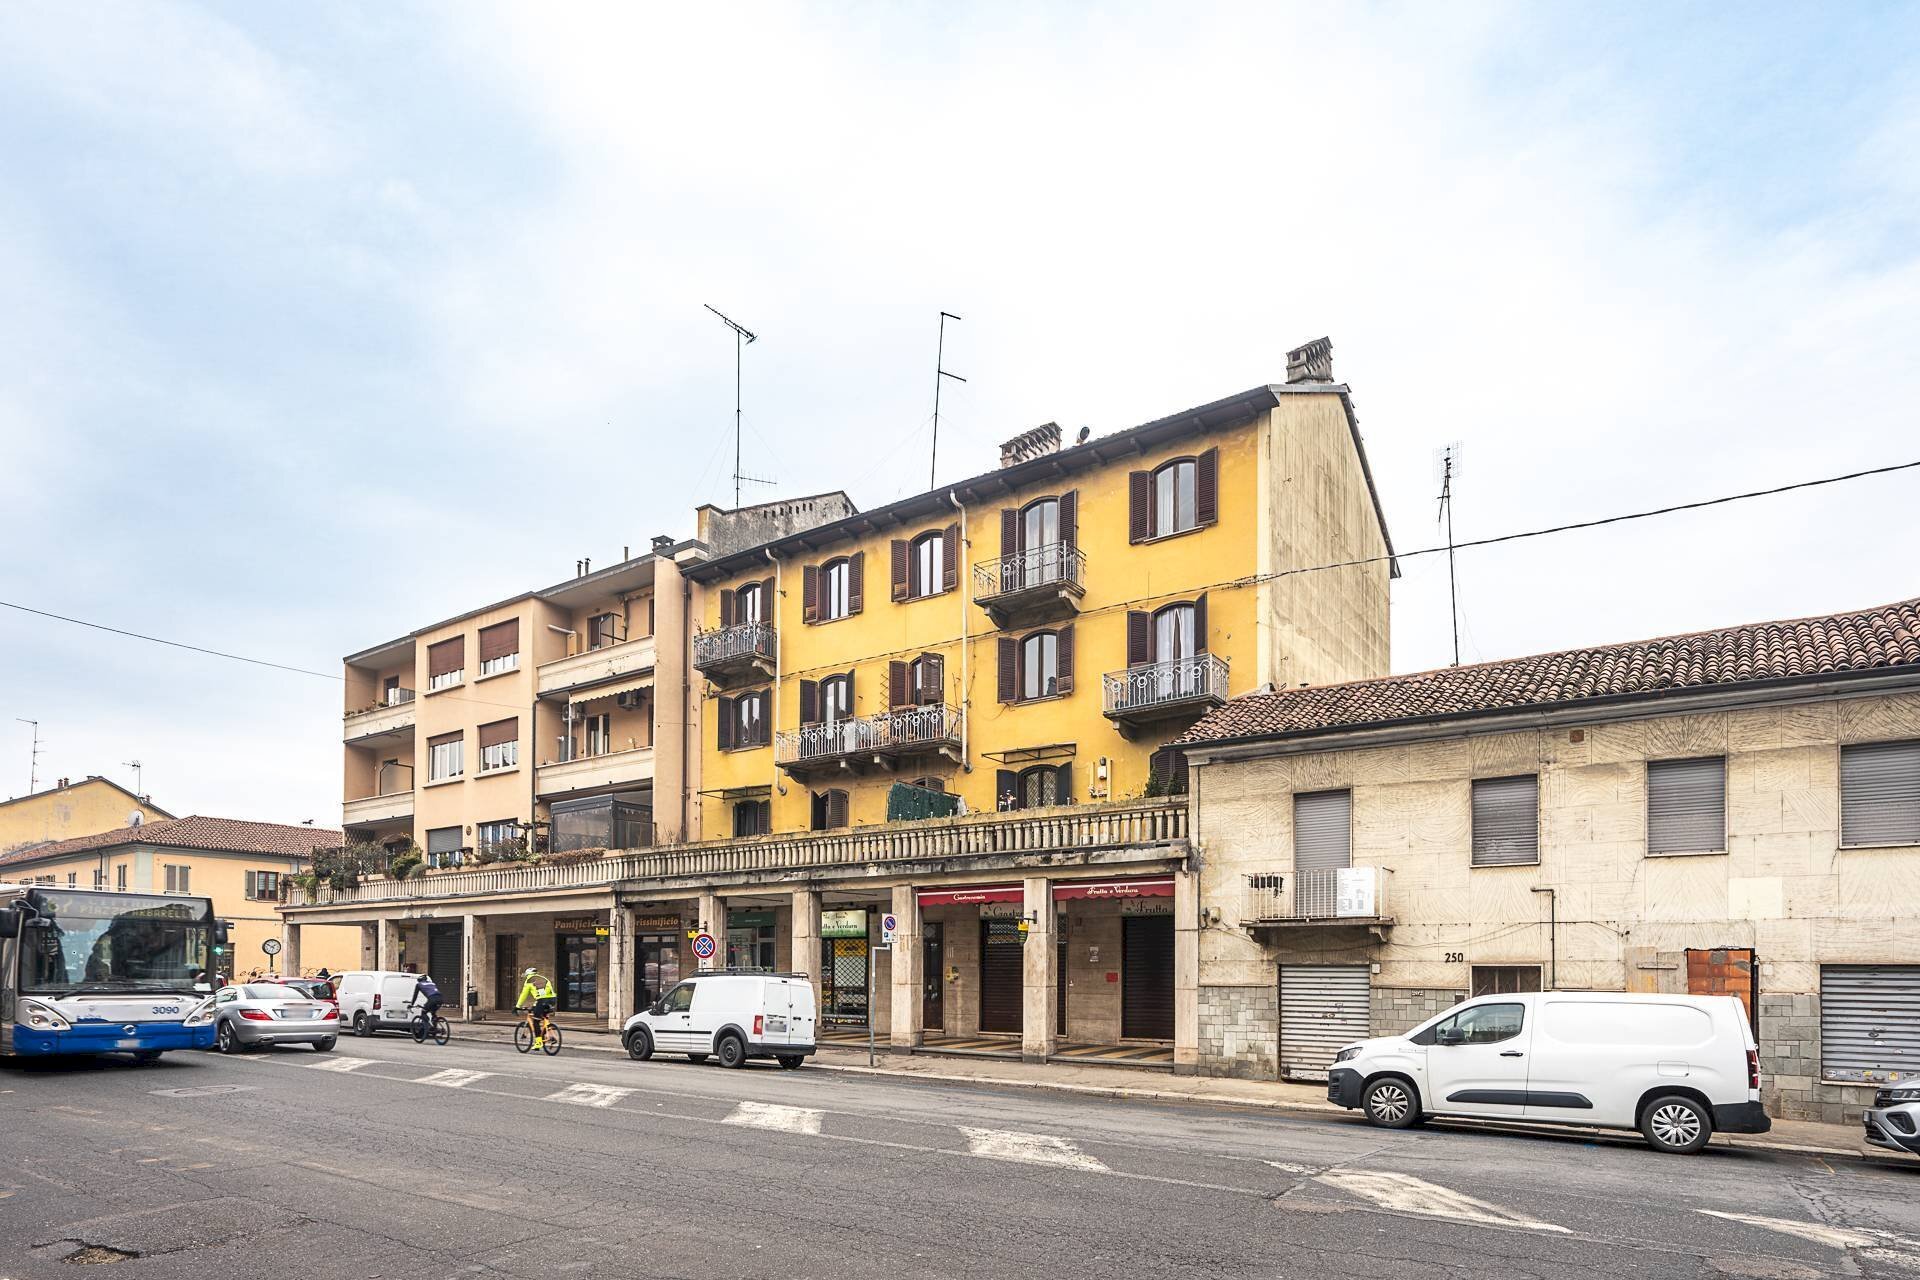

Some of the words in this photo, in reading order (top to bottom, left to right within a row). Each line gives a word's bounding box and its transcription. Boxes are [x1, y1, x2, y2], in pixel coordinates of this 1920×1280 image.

[1087, 886, 1108, 895] Frutta
[1113, 885, 1139, 894] Verdura
[953, 893, 986, 901] Gastronomia
[1136, 900, 1168, 913] Frutta
[1444, 952, 1464, 964] 250
[152, 1006, 180, 1015] 3090
